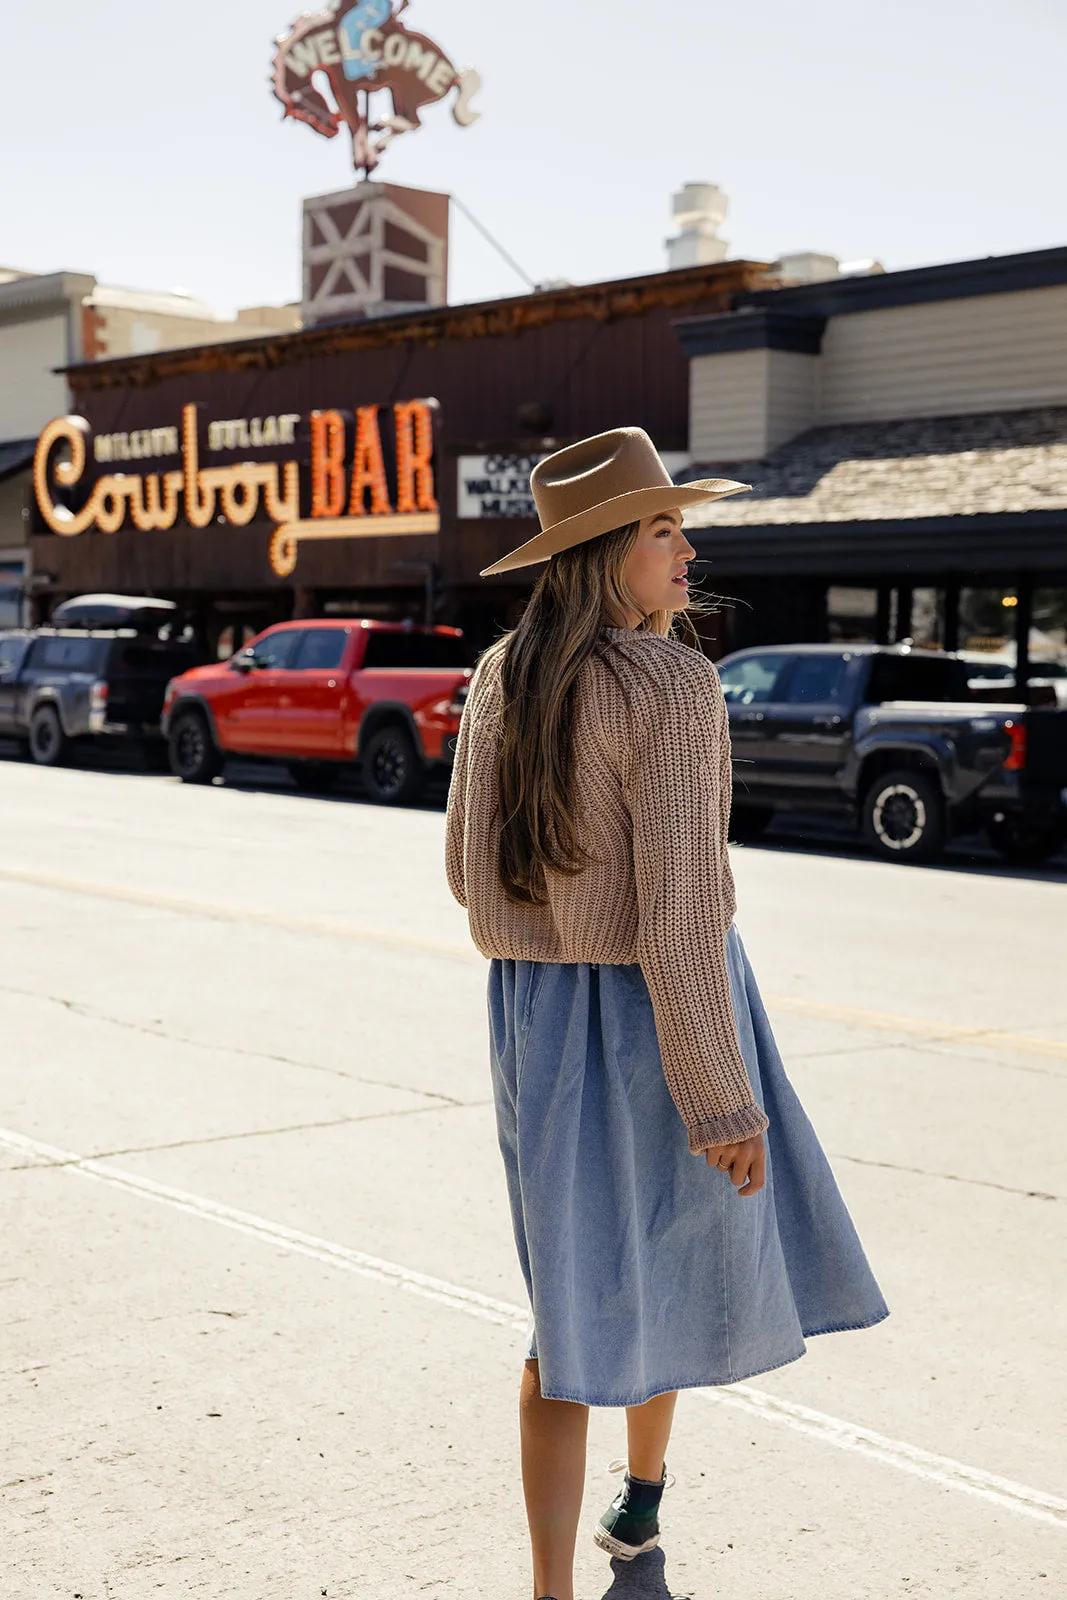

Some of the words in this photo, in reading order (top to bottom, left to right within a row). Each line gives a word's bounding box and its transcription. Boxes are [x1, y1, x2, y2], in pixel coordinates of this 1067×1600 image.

[284, 28, 458, 96] WELCOME
[34, 402, 299, 577] Cowboy
[310, 398, 439, 518] BAR
